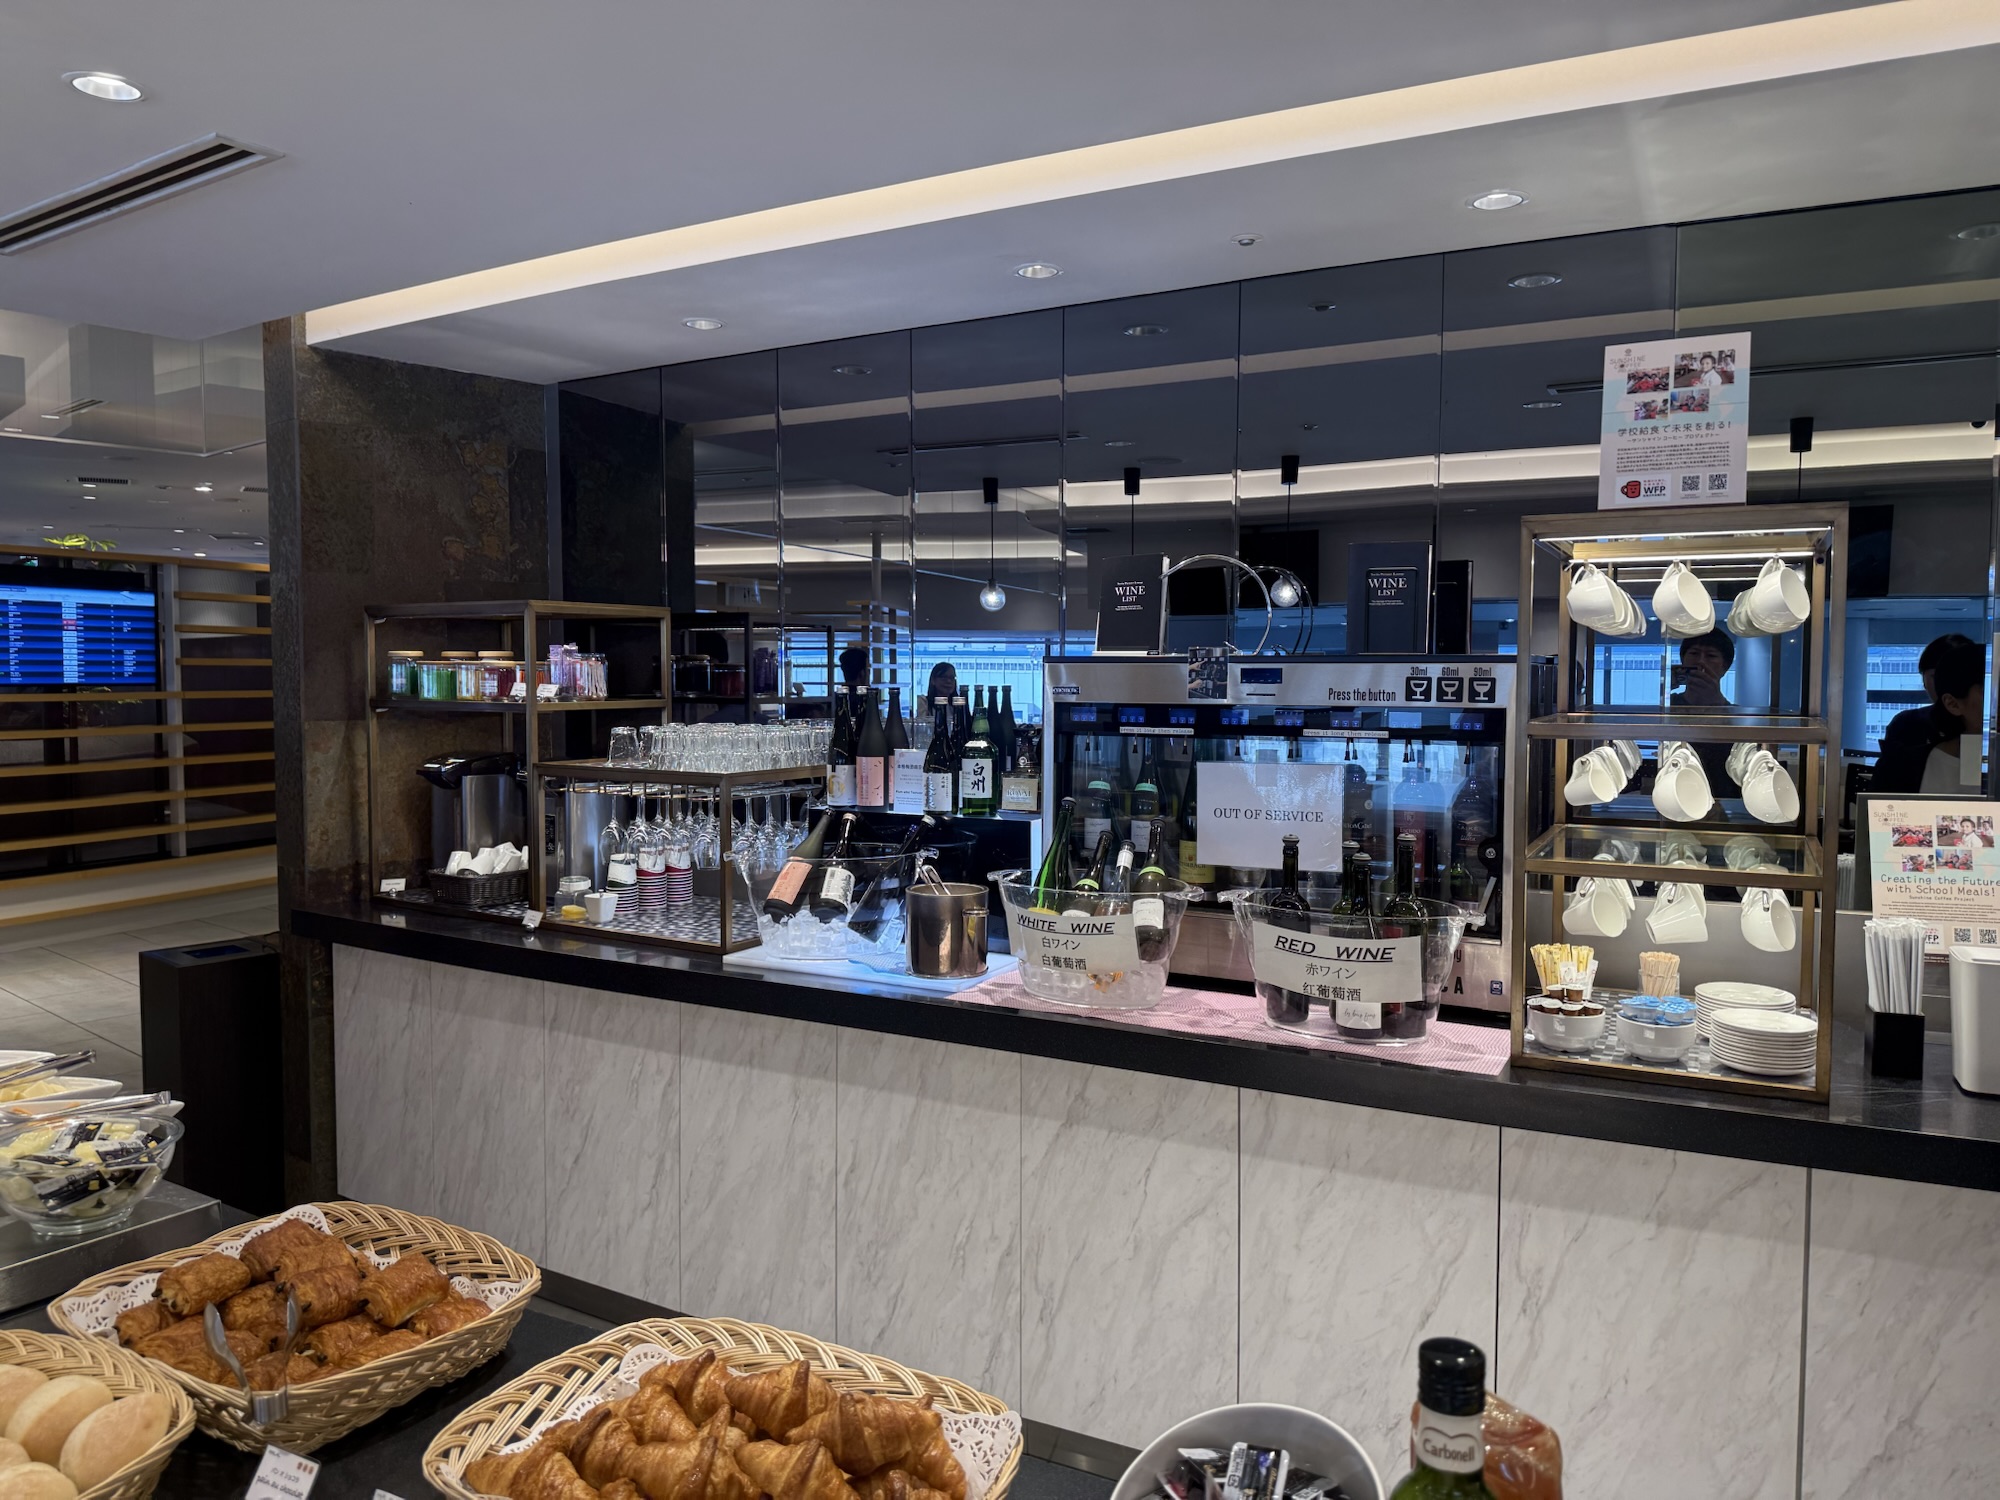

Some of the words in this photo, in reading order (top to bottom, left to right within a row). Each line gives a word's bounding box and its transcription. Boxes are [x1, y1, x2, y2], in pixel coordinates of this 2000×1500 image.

[1643, 485, 1666, 494] WFP
[1367, 577, 1408, 588] WINE
[1114, 585, 1146, 596] WINE
[1122, 595, 1138, 603] LIST
[1410, 666, 1428, 676] 30ml
[1441, 666, 1459, 677] 60ml
[1473, 667, 1492, 677] 90ml
[1328, 687, 1351, 701] Press
[1352, 688, 1366, 701] the
[1368, 688, 1397, 702] button
[971, 762, 986, 793] 白州
[1213, 808, 1242, 819] OUT
[1244, 809, 1262, 820] OF
[1265, 809, 1324, 823] SERVICE
[1880, 873, 1932, 885] Creating
[1938, 875, 1957, 885] the
[1886, 884, 1911, 894] with
[1916, 885, 1953, 895] School
[1957, 886, 1995, 897] Meals!
[1016, 913, 1057, 932] WHITE
[1071, 922, 1116, 934] WINE
[1042, 935, 1081, 951] 白ワイン
[1926, 934, 1939, 942] FP
[1275, 935, 1316, 955] RED
[1336, 946, 1396, 961] WINE
[1042, 954, 1087, 970] 白葡萄酒
[1305, 962, 1357, 980] 赤ワイン
[1422, 1438, 1475, 1462] Carbonell
